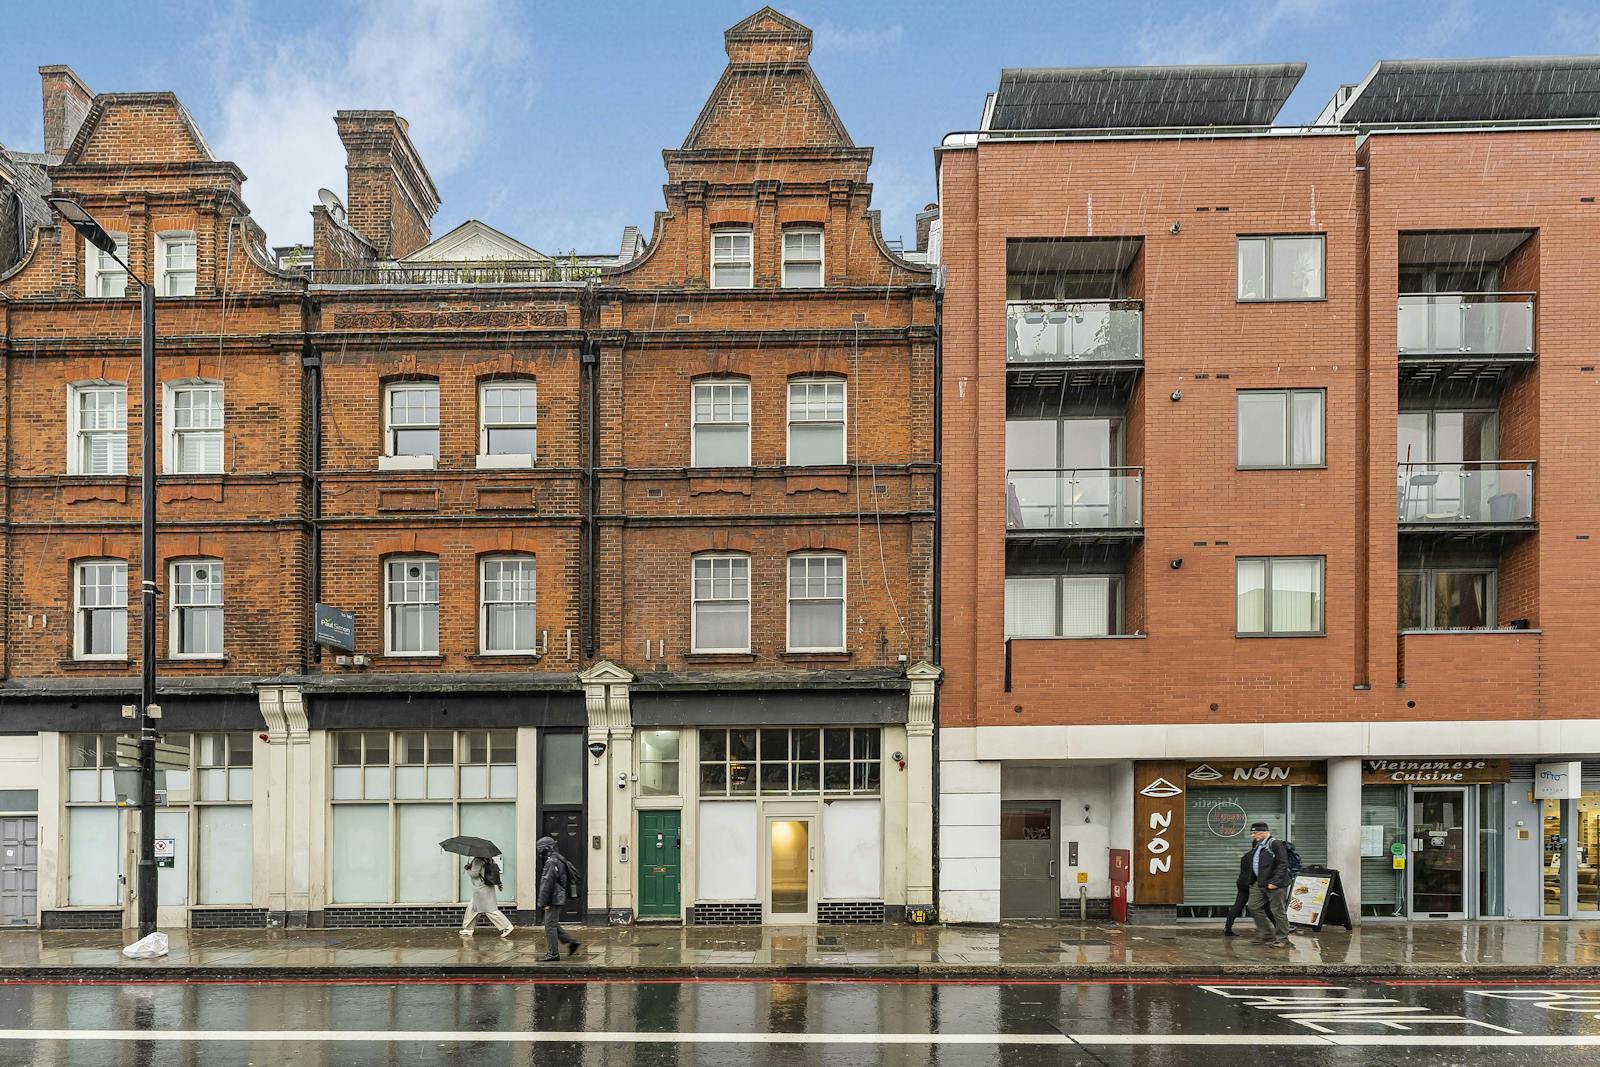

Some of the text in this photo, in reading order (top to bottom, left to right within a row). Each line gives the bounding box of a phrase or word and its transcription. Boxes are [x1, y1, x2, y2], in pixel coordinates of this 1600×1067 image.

[1232, 762, 1291, 781] NÓN
[1369, 760, 1486, 770] Vietnamese
[1391, 771, 1463, 781] Cuisine
[1197, 985, 1522, 1033] LANE
